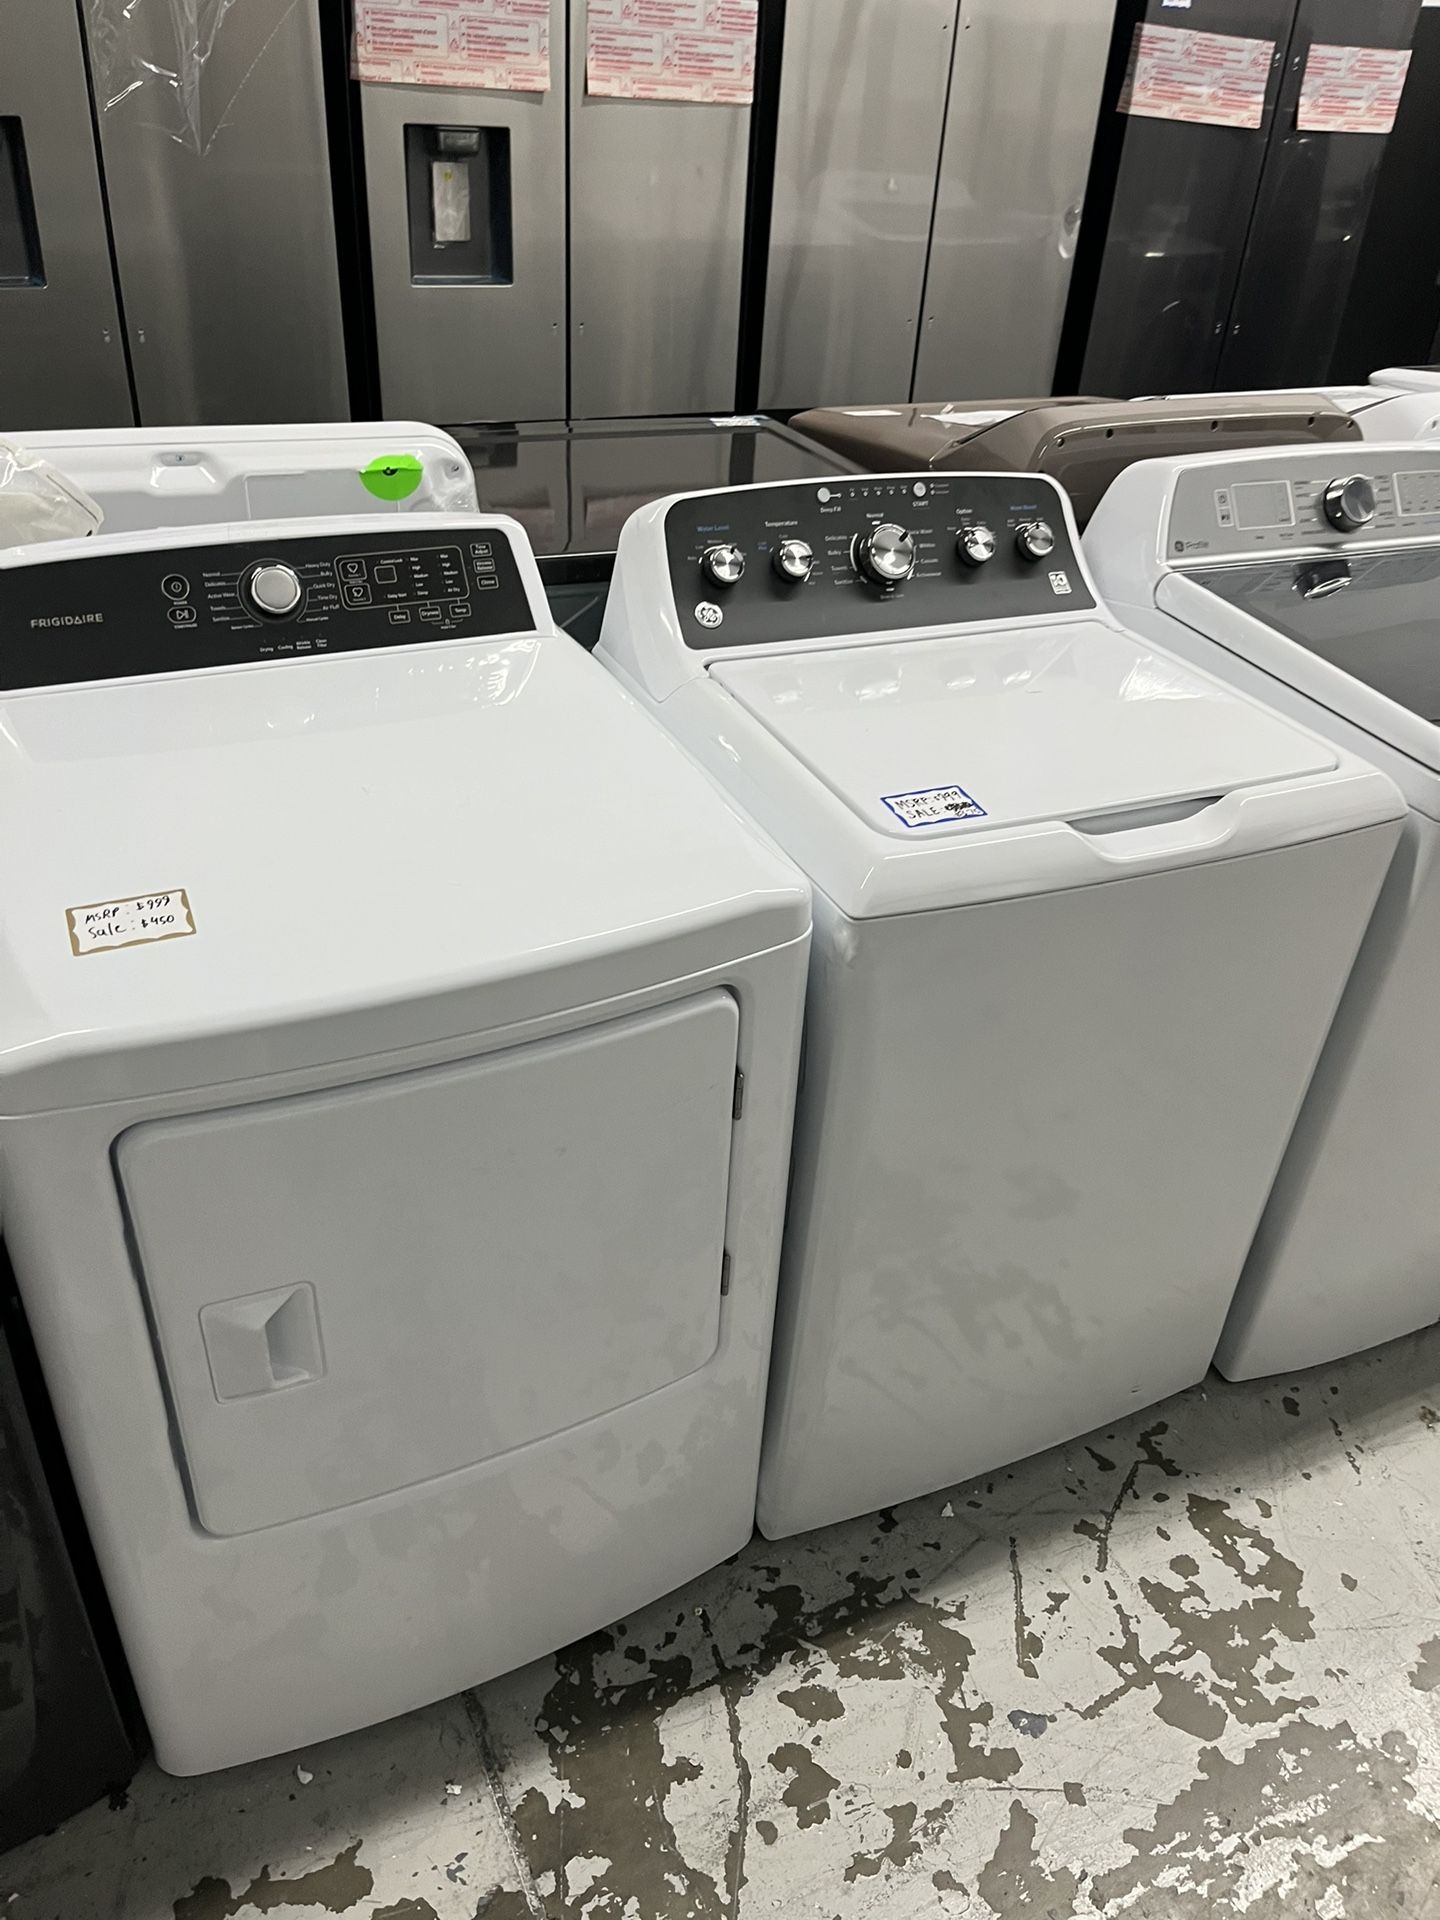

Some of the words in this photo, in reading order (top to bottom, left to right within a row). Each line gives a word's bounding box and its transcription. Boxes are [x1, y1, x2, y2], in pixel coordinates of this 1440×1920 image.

[912, 500, 929, 508] START
[764, 520, 798, 528] Temperature
[30, 613, 103, 628] FRIGIDAIRE
[141, 914, 175, 929] $450
